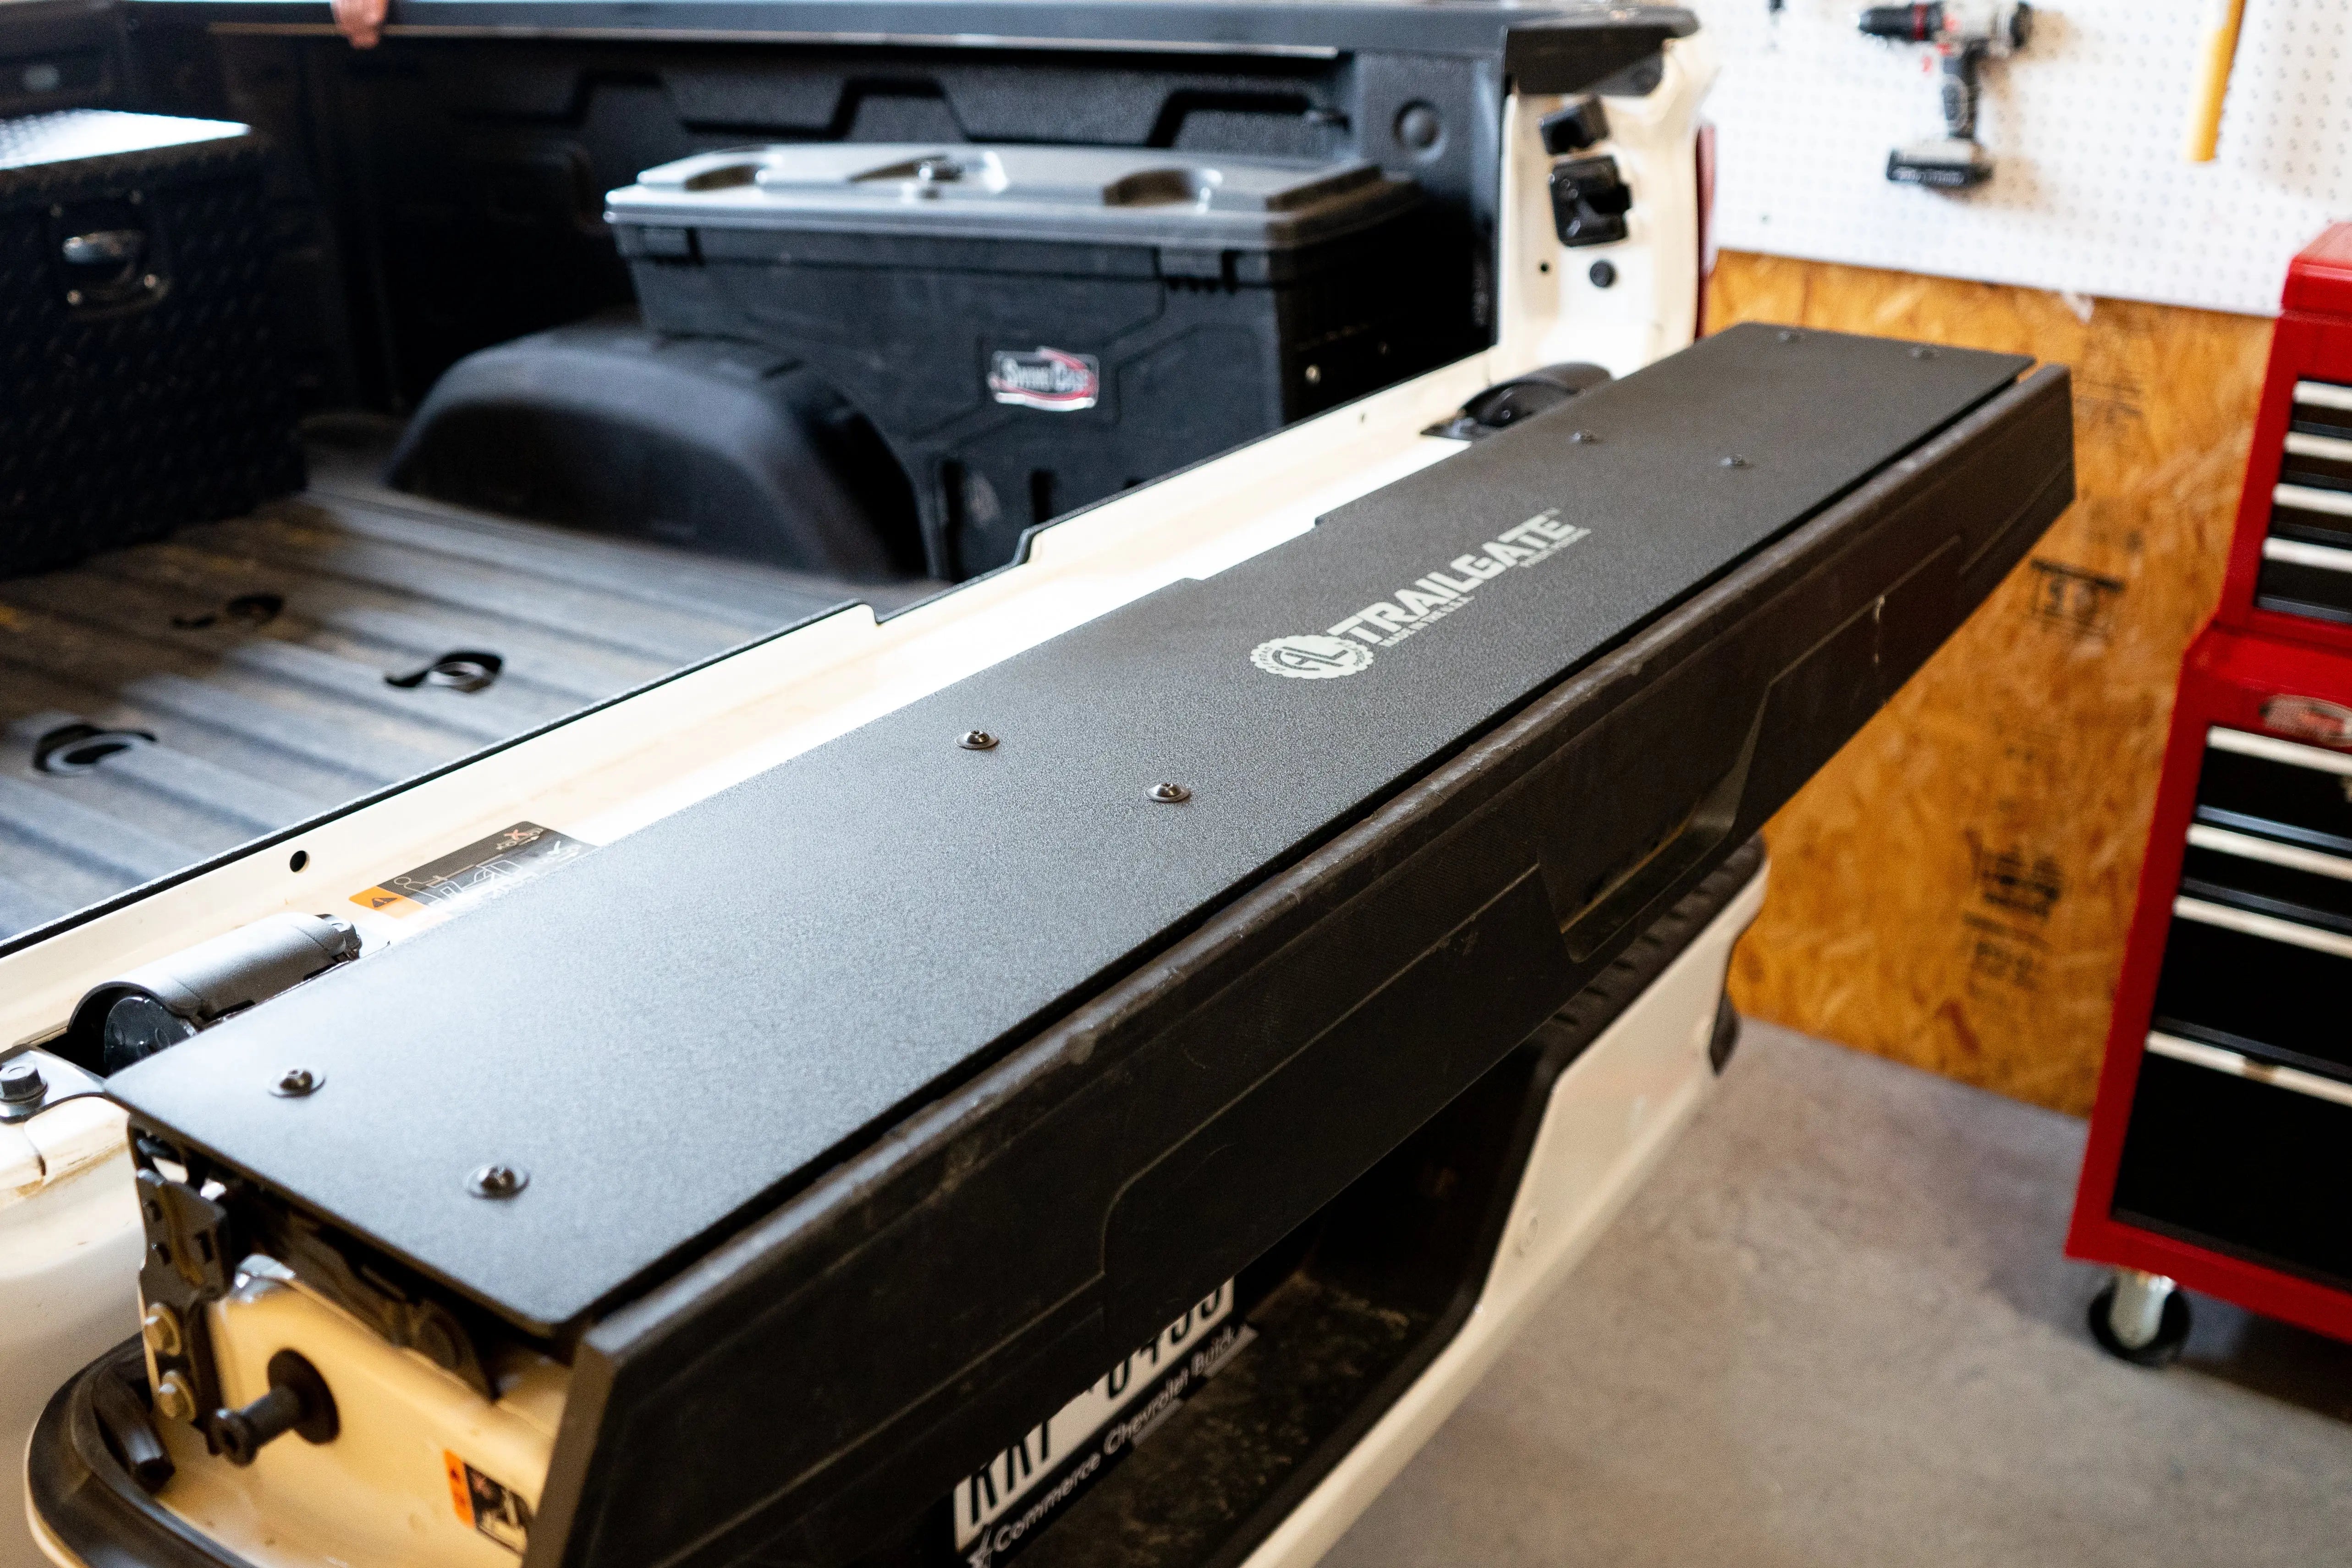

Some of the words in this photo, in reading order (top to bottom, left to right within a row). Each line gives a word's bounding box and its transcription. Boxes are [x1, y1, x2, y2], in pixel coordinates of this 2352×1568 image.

[1327, 514, 1575, 643] TRAILGATE
[1377, 627, 1416, 647] MADE
[1408, 621, 1429, 630] IN
[994, 1452, 1101, 1551] Commerce
[1103, 1366, 1189, 1456] Chevrolet
[1191, 1324, 1237, 1377] Buick
